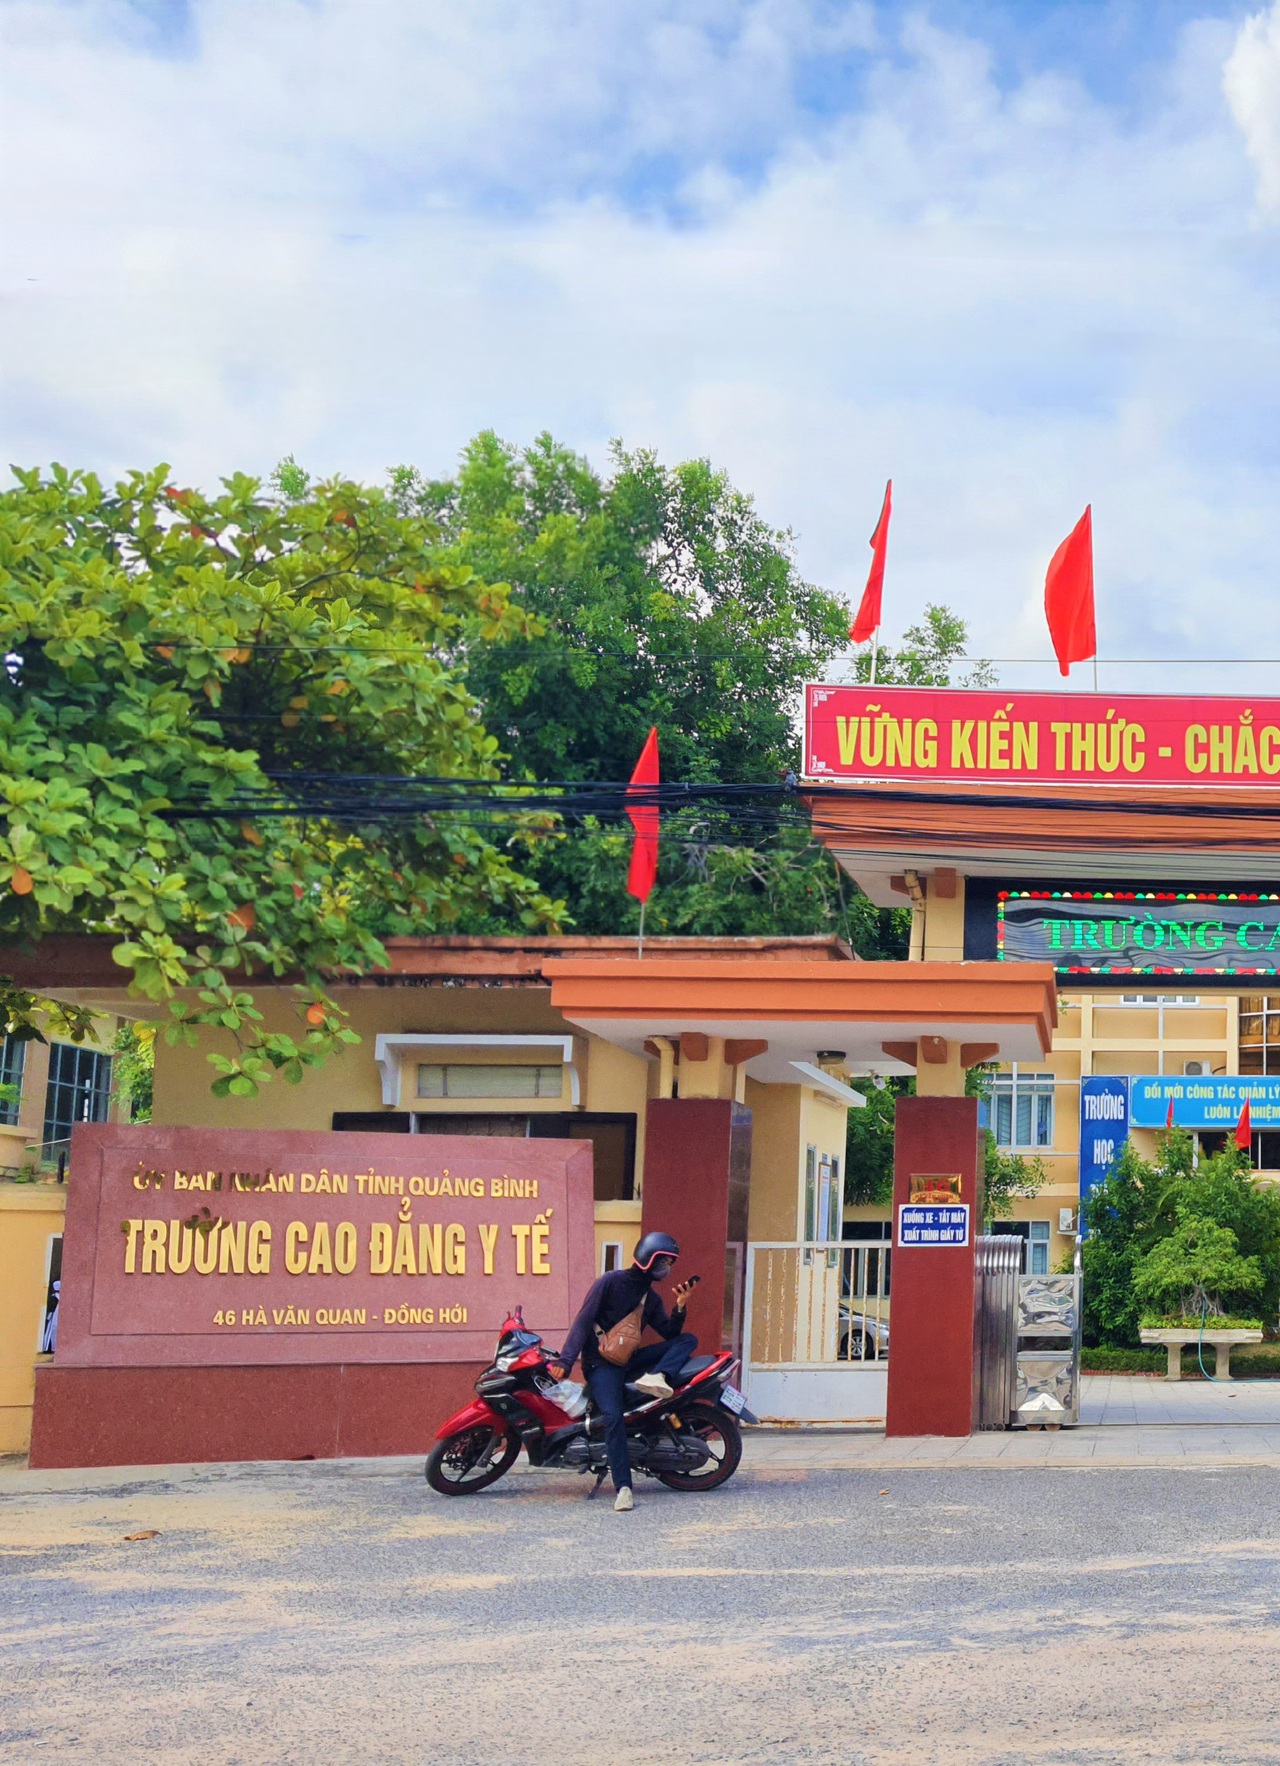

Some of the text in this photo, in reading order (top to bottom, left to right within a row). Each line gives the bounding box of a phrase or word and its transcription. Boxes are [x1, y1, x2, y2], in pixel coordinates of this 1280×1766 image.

[836, 704, 938, 769] VỮNG
[951, 703, 1039, 771] KIẾN
[1050, 709, 1146, 772] THỨC
[1042, 913, 1227, 950] TRƯỜNG
[1084, 1089, 1125, 1120] TRƯỜNG
[1164, 1083, 1184, 1099] MỚI
[1186, 1084, 1214, 1099] CÔNG
[1216, 1084, 1236, 1099] TÁC
[1238, 1081, 1266, 1100] QUẢN
[1204, 1104, 1231, 1119] LUÔN
[1249, 1104, 1280, 1121] NHIỆM
[1093, 1139, 1114, 1170] HỌC
[300, 1168, 348, 1194] DÂN
[355, 1167, 404, 1195] TỈNH
[408, 1170, 484, 1197] QUẢNG
[490, 1174, 538, 1198] BÌNH
[903, 1209, 924, 1223] XUỐNG
[925, 1212, 934, 1223] XE
[285, 1221, 357, 1274] CAO
[369, 1197, 466, 1275] ĐẲNG
[478, 1224, 499, 1274] Y
[512, 1208, 554, 1275] TẾ
[213, 1303, 467, 1326] 46 HÀ VĂN QUAN ĐỒNG HỚI
